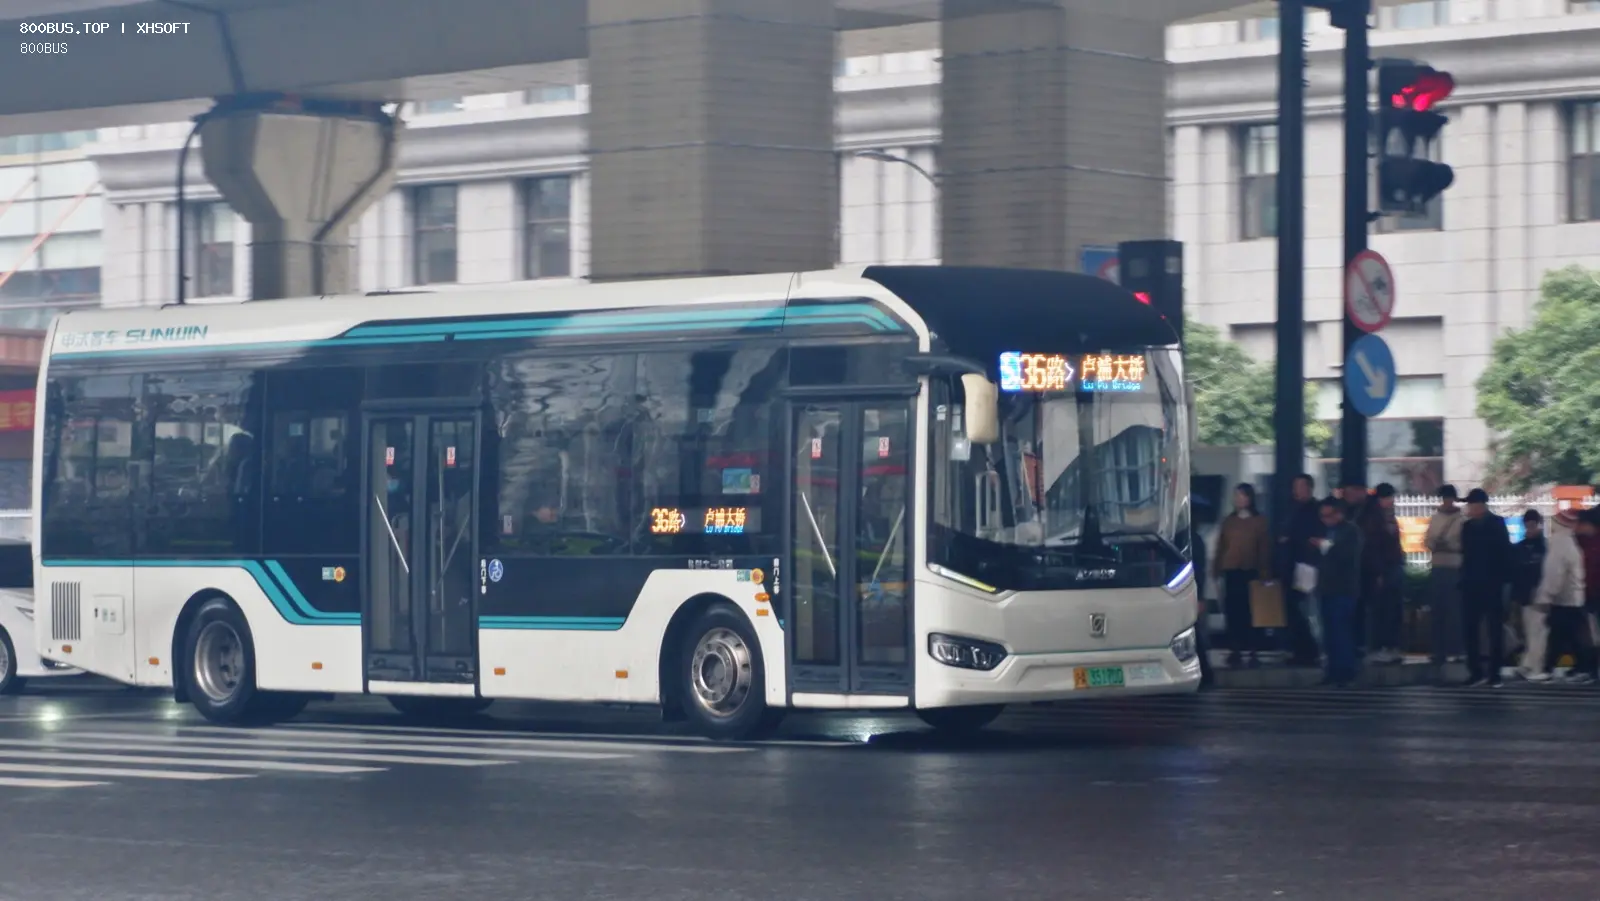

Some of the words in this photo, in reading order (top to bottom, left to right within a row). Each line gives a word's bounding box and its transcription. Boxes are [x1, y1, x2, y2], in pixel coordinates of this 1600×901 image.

[125, 325, 208, 344] SUNWIN
[1081, 354, 1145, 381] 卢浦大桥
[651, 507, 682, 534] 36路
